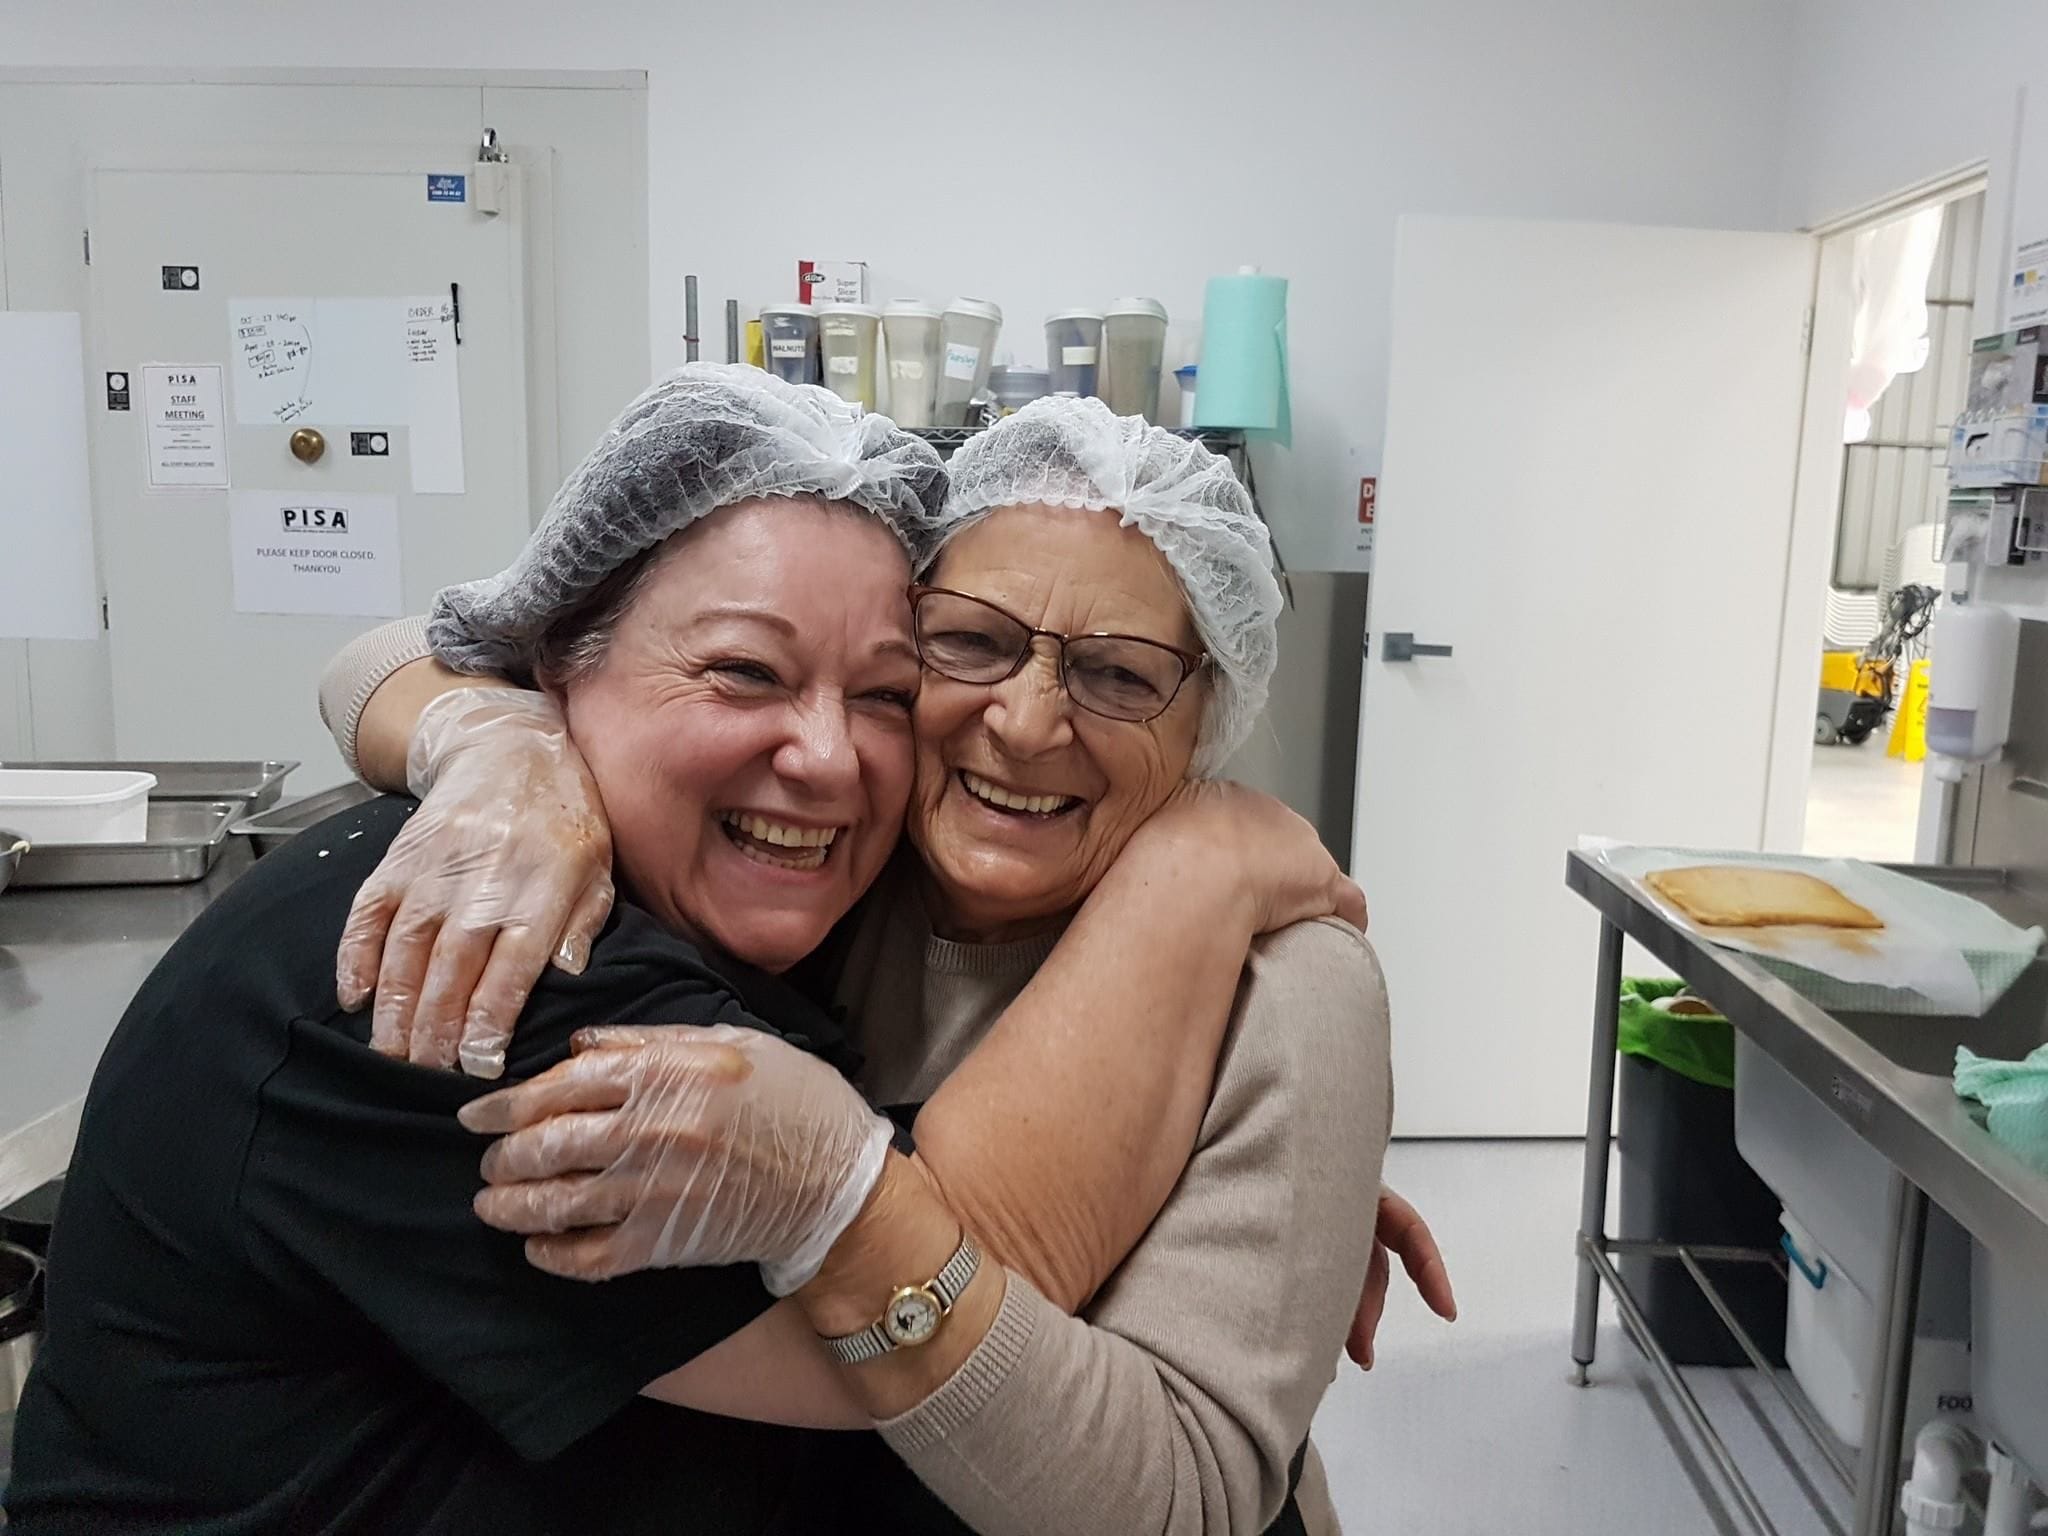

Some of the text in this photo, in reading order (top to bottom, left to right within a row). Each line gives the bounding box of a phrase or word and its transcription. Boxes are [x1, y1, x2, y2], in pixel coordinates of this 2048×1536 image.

[836, 279, 857, 287] Super
[168, 375, 197, 384] PISA
[171, 395, 196, 404] STAFF
[165, 410, 205, 420] MEETING
[283, 509, 346, 529] PISA
[257, 548, 286, 557] PLEASE
[289, 549, 310, 558] KEEP
[313, 549, 338, 558] DOOR
[293, 564, 341, 574] THANKYOU
